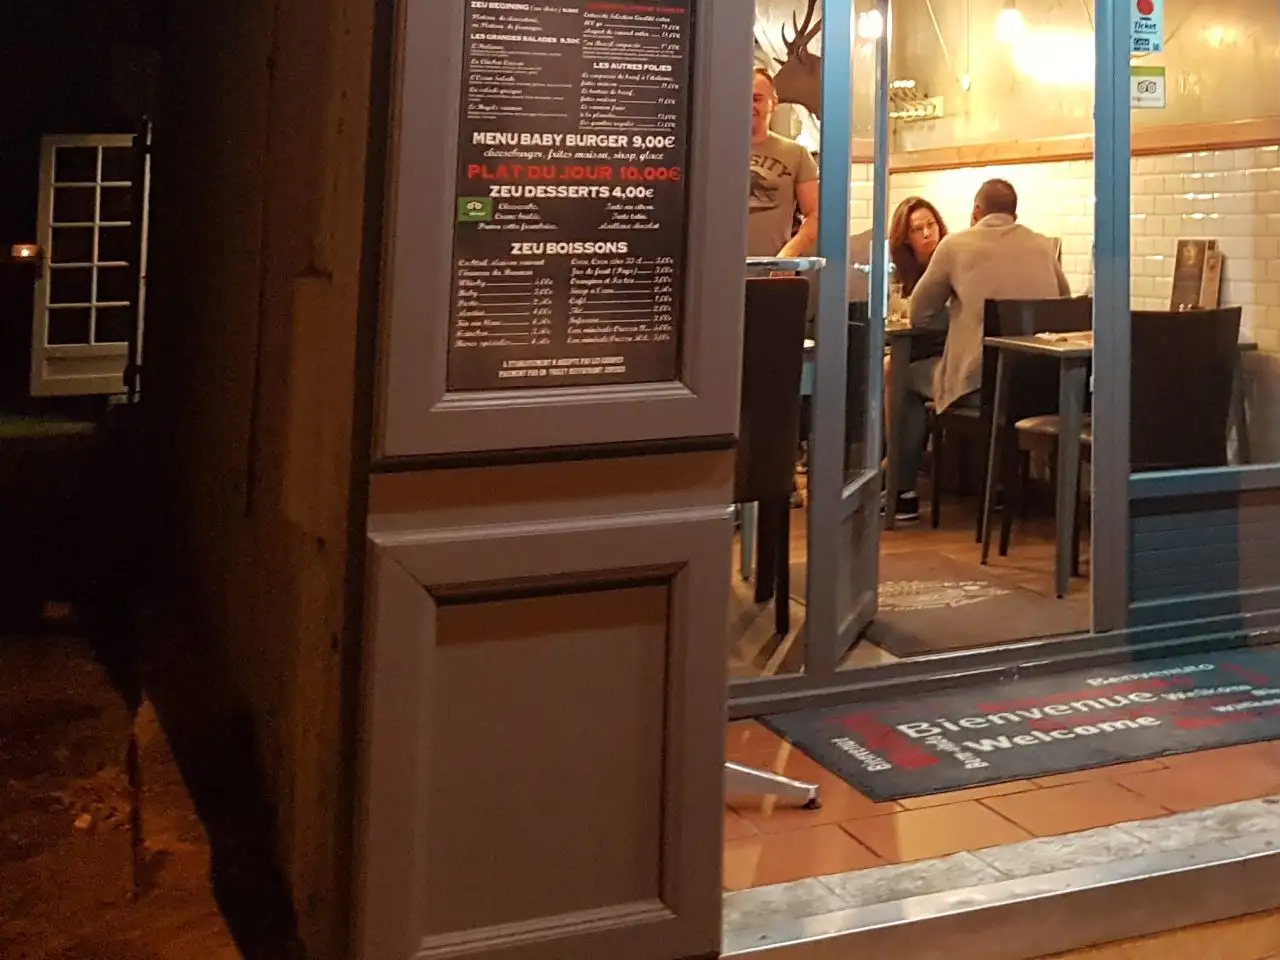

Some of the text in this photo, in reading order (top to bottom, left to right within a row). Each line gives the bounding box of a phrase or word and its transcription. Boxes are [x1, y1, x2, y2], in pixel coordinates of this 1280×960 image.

[610, 63, 643, 71] AUTRES
[473, 132, 675, 149] MENU BABY BURGER 9,00€
[468, 164, 523, 180] PLAT
[528, 166, 554, 180] DU
[559, 166, 612, 180] JOUR
[489, 185, 654, 200] ZEU DESSERTS 4,00€
[511, 242, 628, 255] ZEU BOISSONS
[896, 691, 1159, 739] Bienvenue
[961, 715, 1163, 751] Welcome
